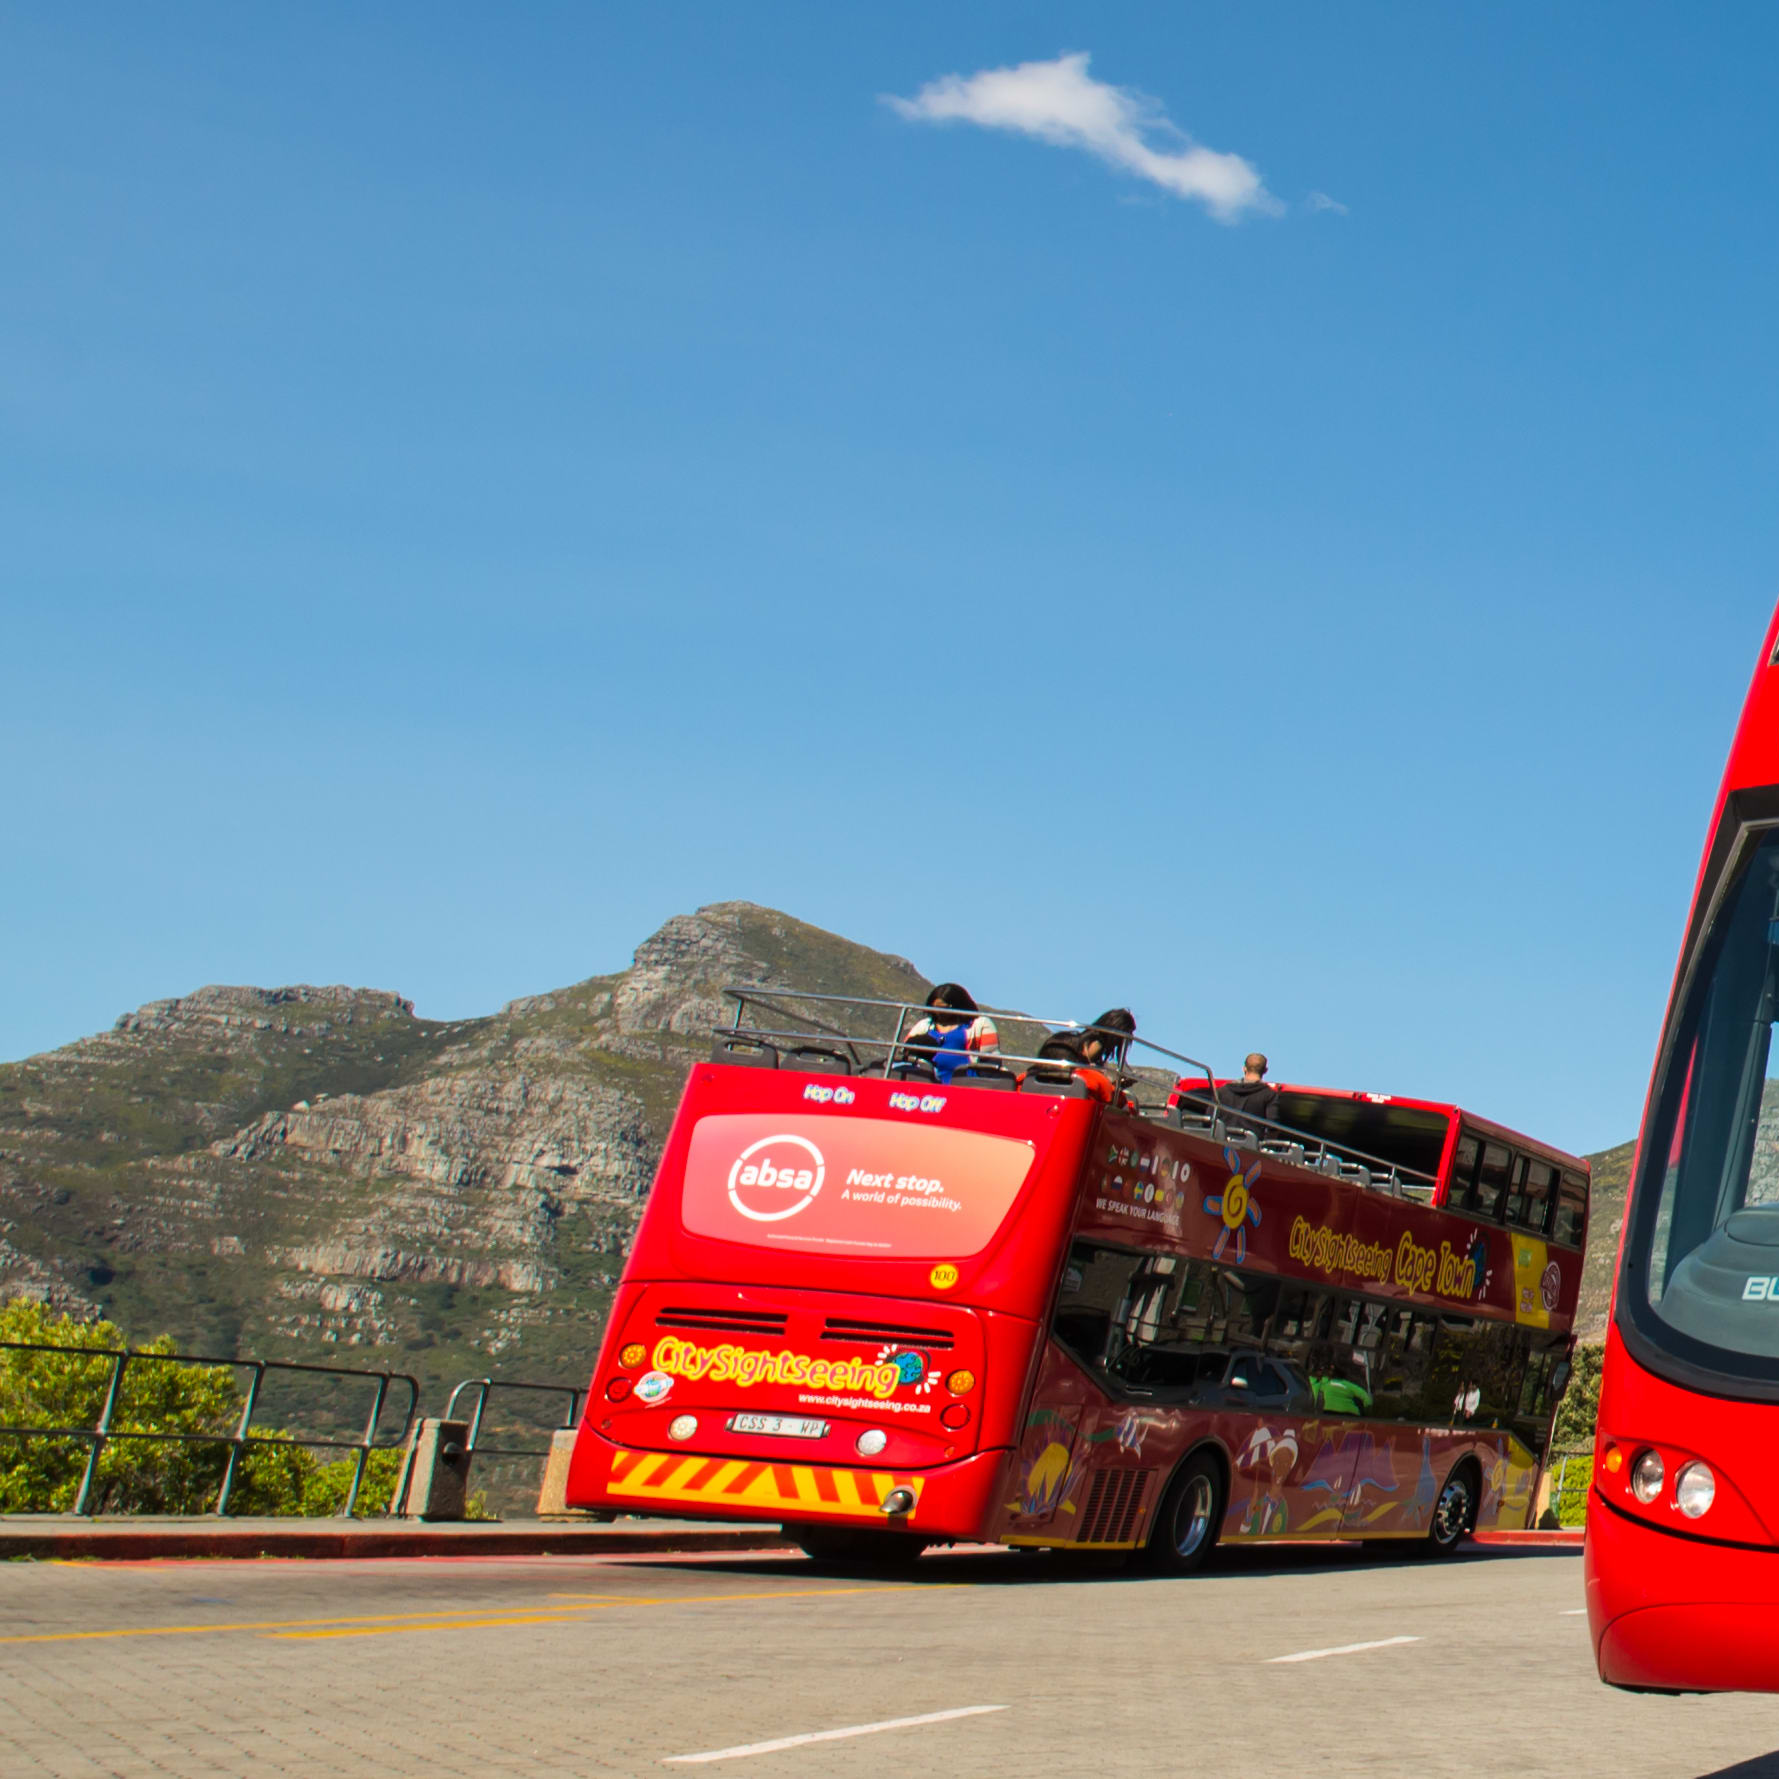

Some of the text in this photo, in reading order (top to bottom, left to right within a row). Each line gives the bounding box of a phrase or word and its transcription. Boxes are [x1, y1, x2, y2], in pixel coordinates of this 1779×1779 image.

[804, 1084, 855, 1104] Hop On
[889, 1092, 919, 1111] Hop
[740, 1158, 813, 1190] absa
[846, 1168, 944, 1195] Next stop.
[841, 1189, 962, 1212] A world of possibility.
[1096, 1197, 1107, 1210] WE
[1107, 1200, 1128, 1214] SPEAK
[1129, 1205, 1147, 1219] YOUR
[1289, 1215, 1393, 1286] CitySightseeing
[1395, 1231, 1436, 1296] Cape
[1437, 1241, 1476, 1298] Town
[653, 1336, 900, 1398] CitySightseeing
[799, 1393, 931, 1413] www.citysightseeing.co.za
[739, 1416, 766, 1431] CSS
[772, 1418, 782, 1431] 3
[801, 1420, 819, 1435] WP
